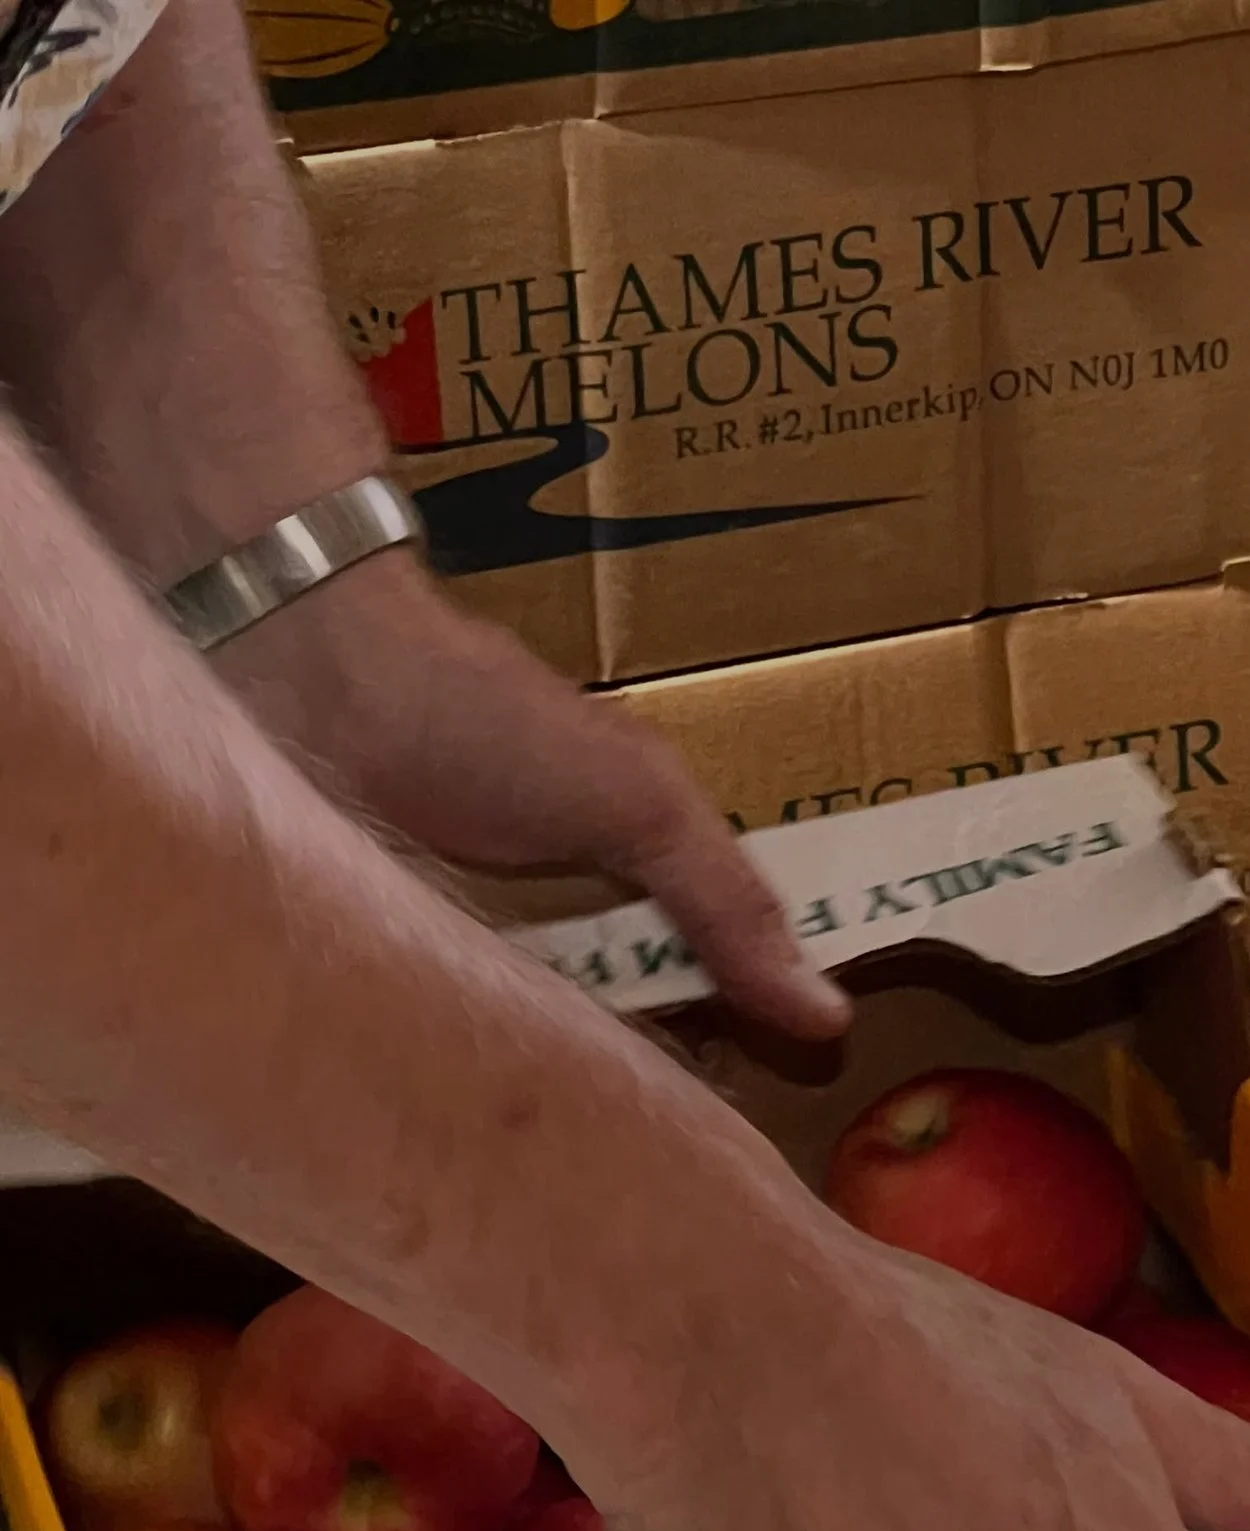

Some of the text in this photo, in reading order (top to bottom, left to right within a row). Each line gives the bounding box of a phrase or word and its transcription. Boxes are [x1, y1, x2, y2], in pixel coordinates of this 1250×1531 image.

[440, 174, 1205, 365] THAMES RIVER
[459, 303, 900, 441] MELONS
[675, 416, 753, 460] R.R.
[756, 411, 815, 448] #2,
[988, 362, 1058, 403] ON
[862, 820, 1131, 924] FAMILY
